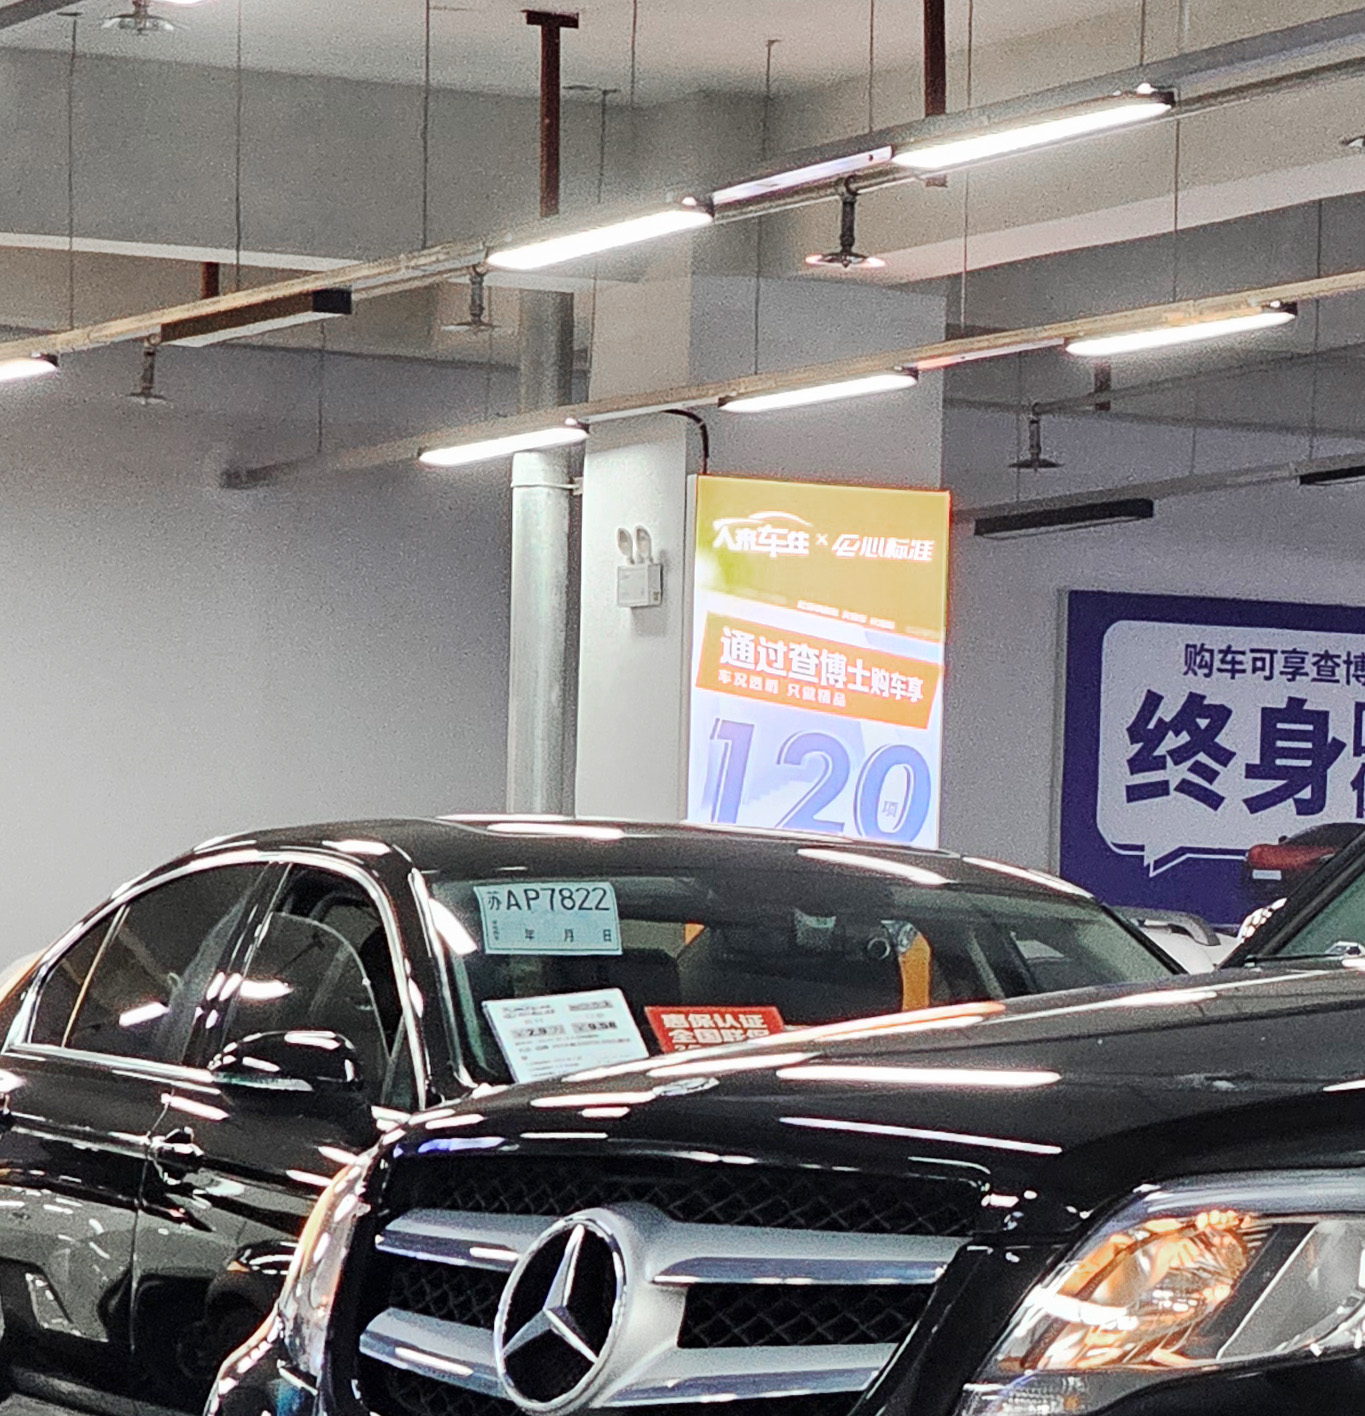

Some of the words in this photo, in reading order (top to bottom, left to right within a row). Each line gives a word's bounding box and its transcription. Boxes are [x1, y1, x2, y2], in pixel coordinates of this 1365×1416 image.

[720, 626, 924, 703] 通过查博士购车享
[709, 717, 932, 843] 120
[1126, 688, 1346, 815] 终身
